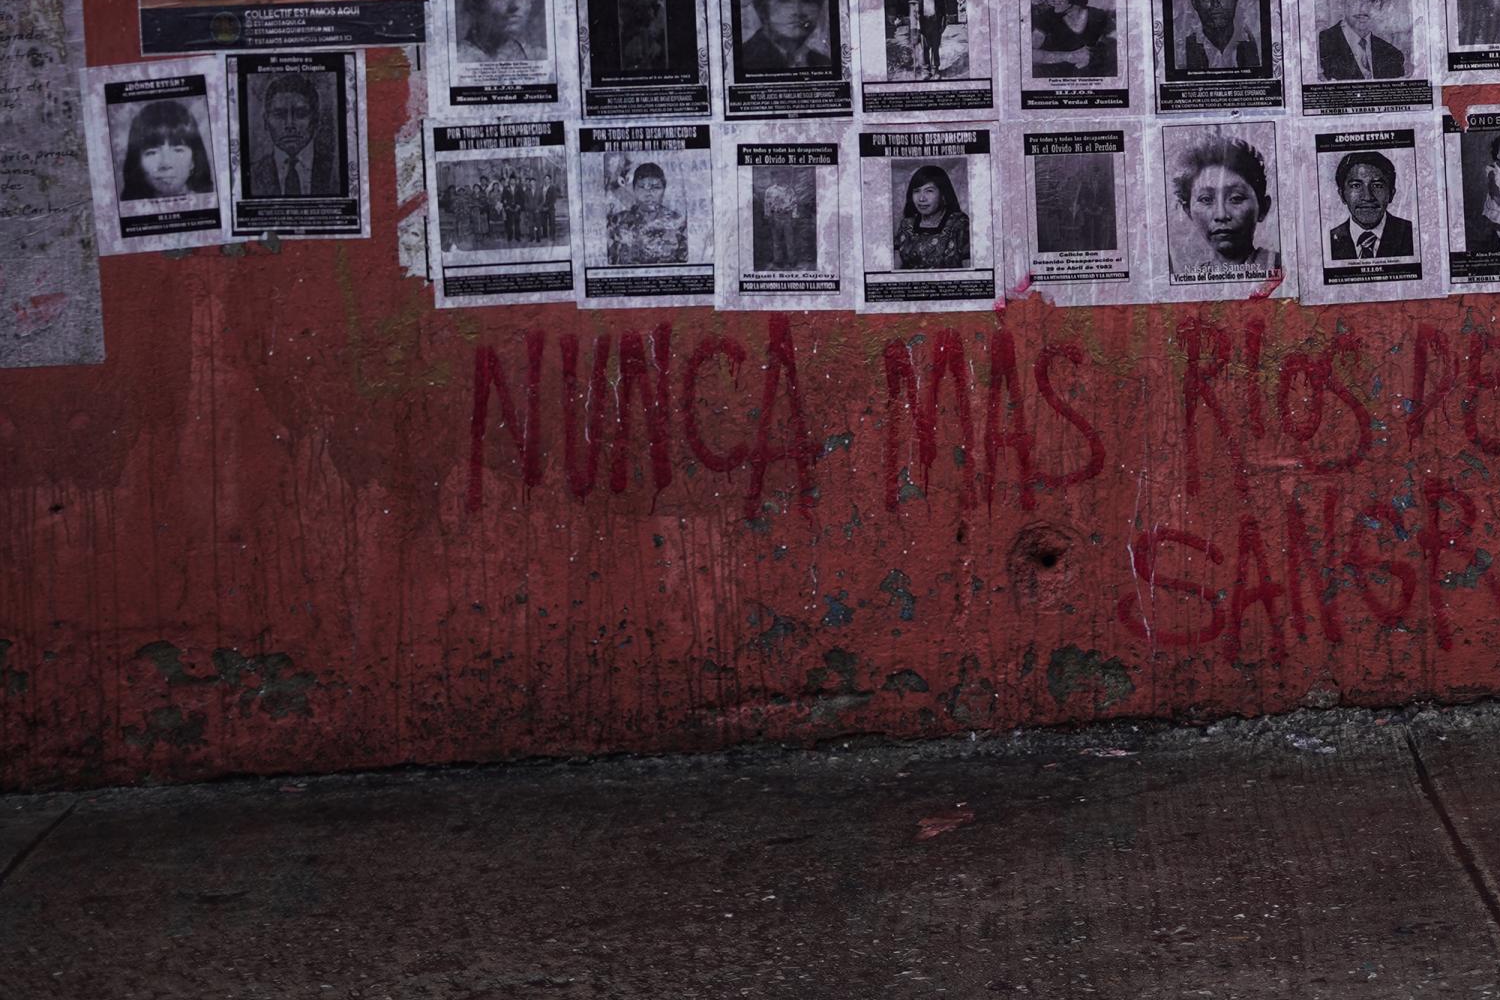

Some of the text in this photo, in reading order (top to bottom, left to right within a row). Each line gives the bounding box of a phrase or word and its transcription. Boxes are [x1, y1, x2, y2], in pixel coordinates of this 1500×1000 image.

[1042, 145, 1048, 153] el
[1085, 144, 1092, 152] el
[1174, 273, 1196, 282] Victima
[1197, 272, 1206, 281] del
[1208, 271, 1235, 281] Genocidio
[1237, 271, 1244, 279] en
[1245, 270, 1266, 279] Rabinal
[465, 313, 823, 522] NUNCA
[884, 324, 1106, 512] MAS
[1178, 315, 1372, 496] RIOS
